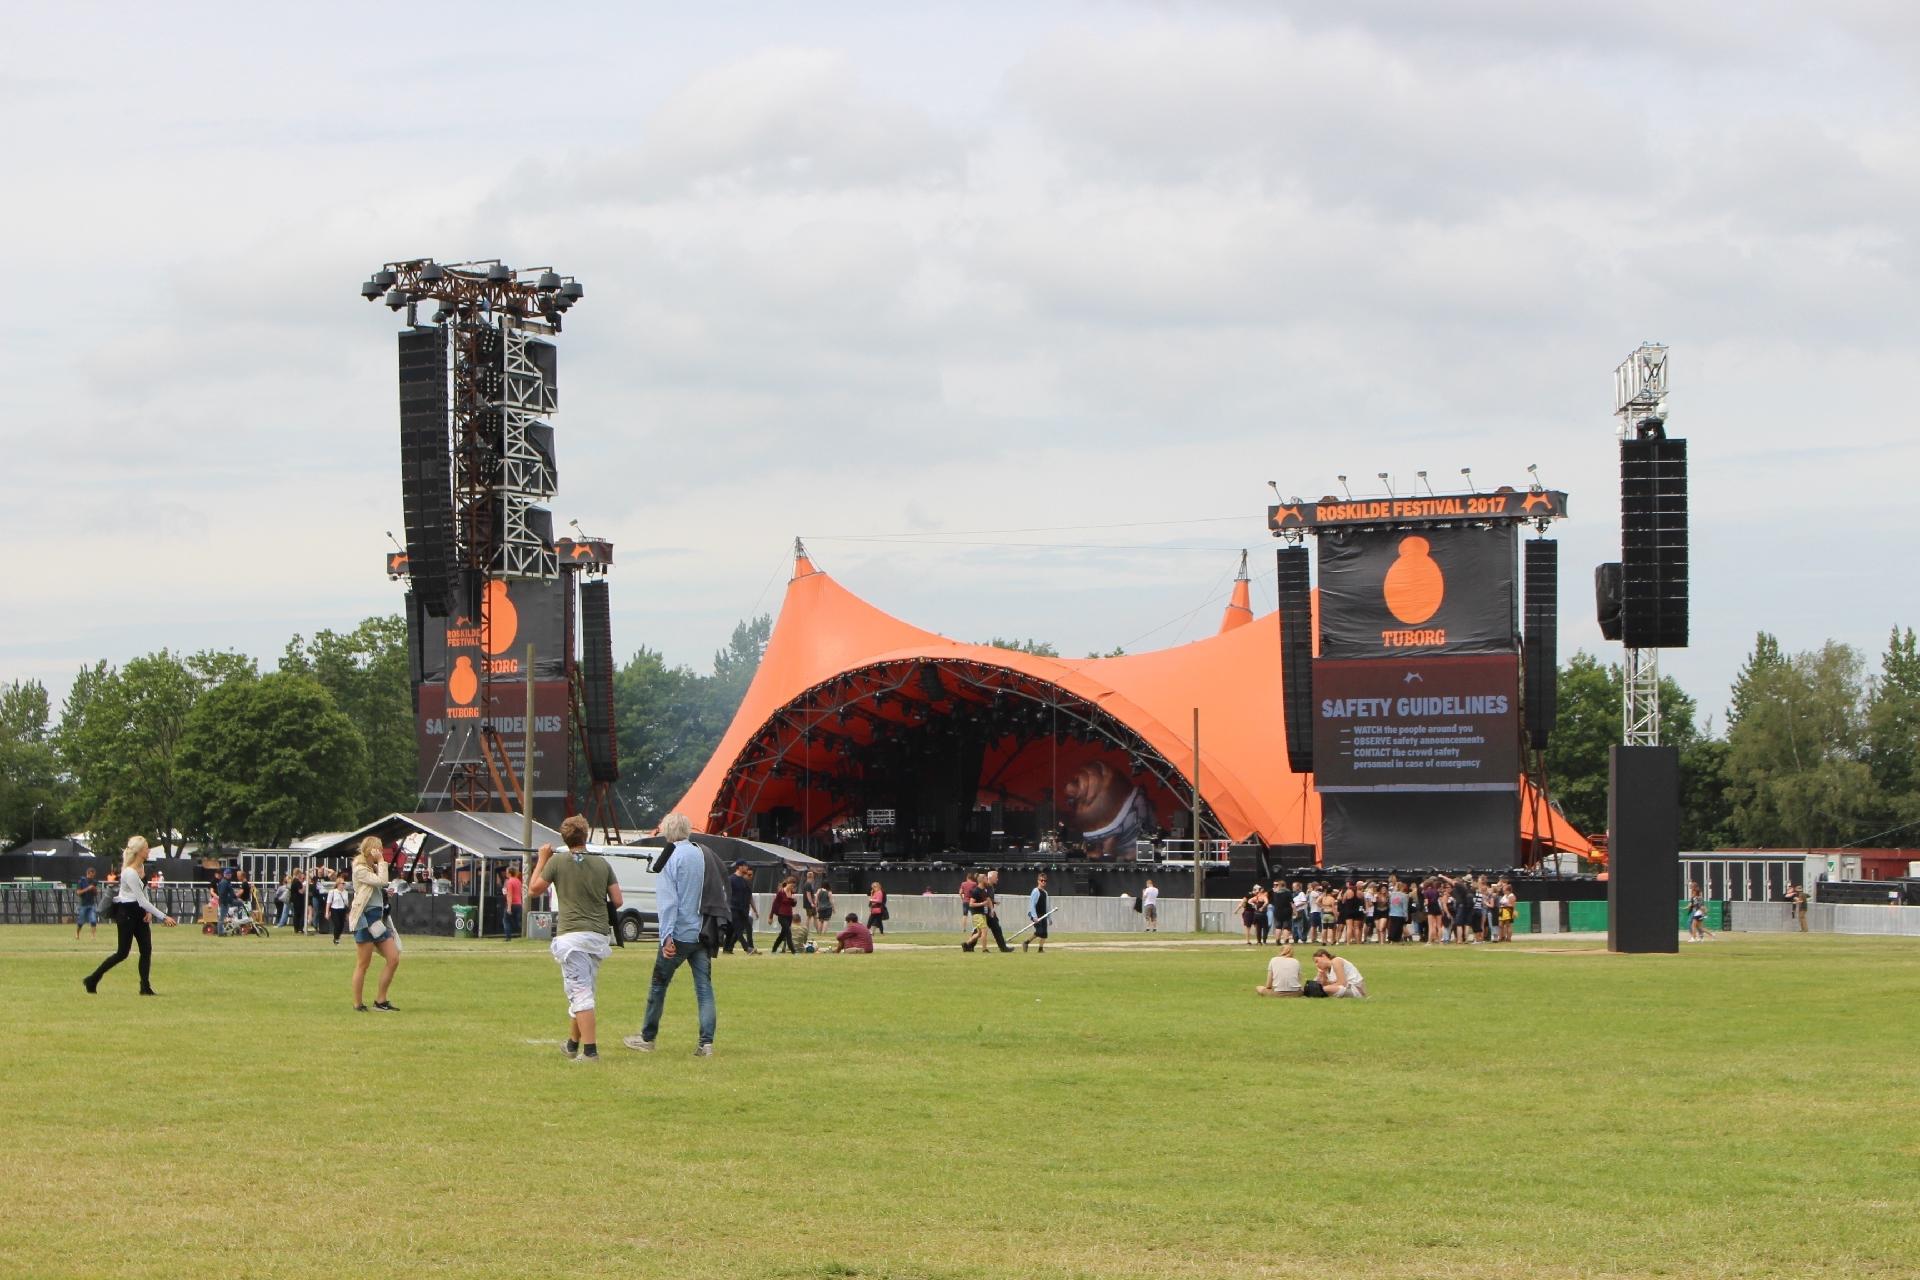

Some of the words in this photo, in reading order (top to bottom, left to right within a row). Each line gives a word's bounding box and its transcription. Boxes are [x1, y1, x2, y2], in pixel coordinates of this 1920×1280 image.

[1316, 502, 1391, 522] ROSKILDE
[1393, 498, 1464, 519] FESTIVAL
[1467, 496, 1507, 513] 2017
[447, 629, 481, 639] ROSKILDE
[1382, 629, 1445, 647] TUBORG
[447, 638, 480, 647] FESTIVAL
[1322, 698, 1392, 717] SAFETY
[1397, 696, 1508, 716] GUIDELINES
[447, 707, 480, 718] TUBORG
[1353, 726, 1383, 734] WATCH
[1384, 726, 1398, 734] the
[1398, 725, 1427, 735] people
[1428, 724, 1457, 733] around
[1458, 725, 1473, 734] you
[1353, 737, 1392, 746] OBSERVE
[1393, 737, 1419, 747] safety
[1419, 736, 1485, 745] announcements
[1353, 748, 1391, 757] CONTACT
[1392, 748, 1406, 757] the
[1407, 747, 1433, 756] crowd
[1434, 747, 1460, 758] safety
[1353, 759, 1394, 770] personnel
[1395, 759, 1404, 768] in
[1405, 760, 1424, 768] case
[1425, 759, 1434, 768] of
[1435, 759, 1481, 769] emergency
